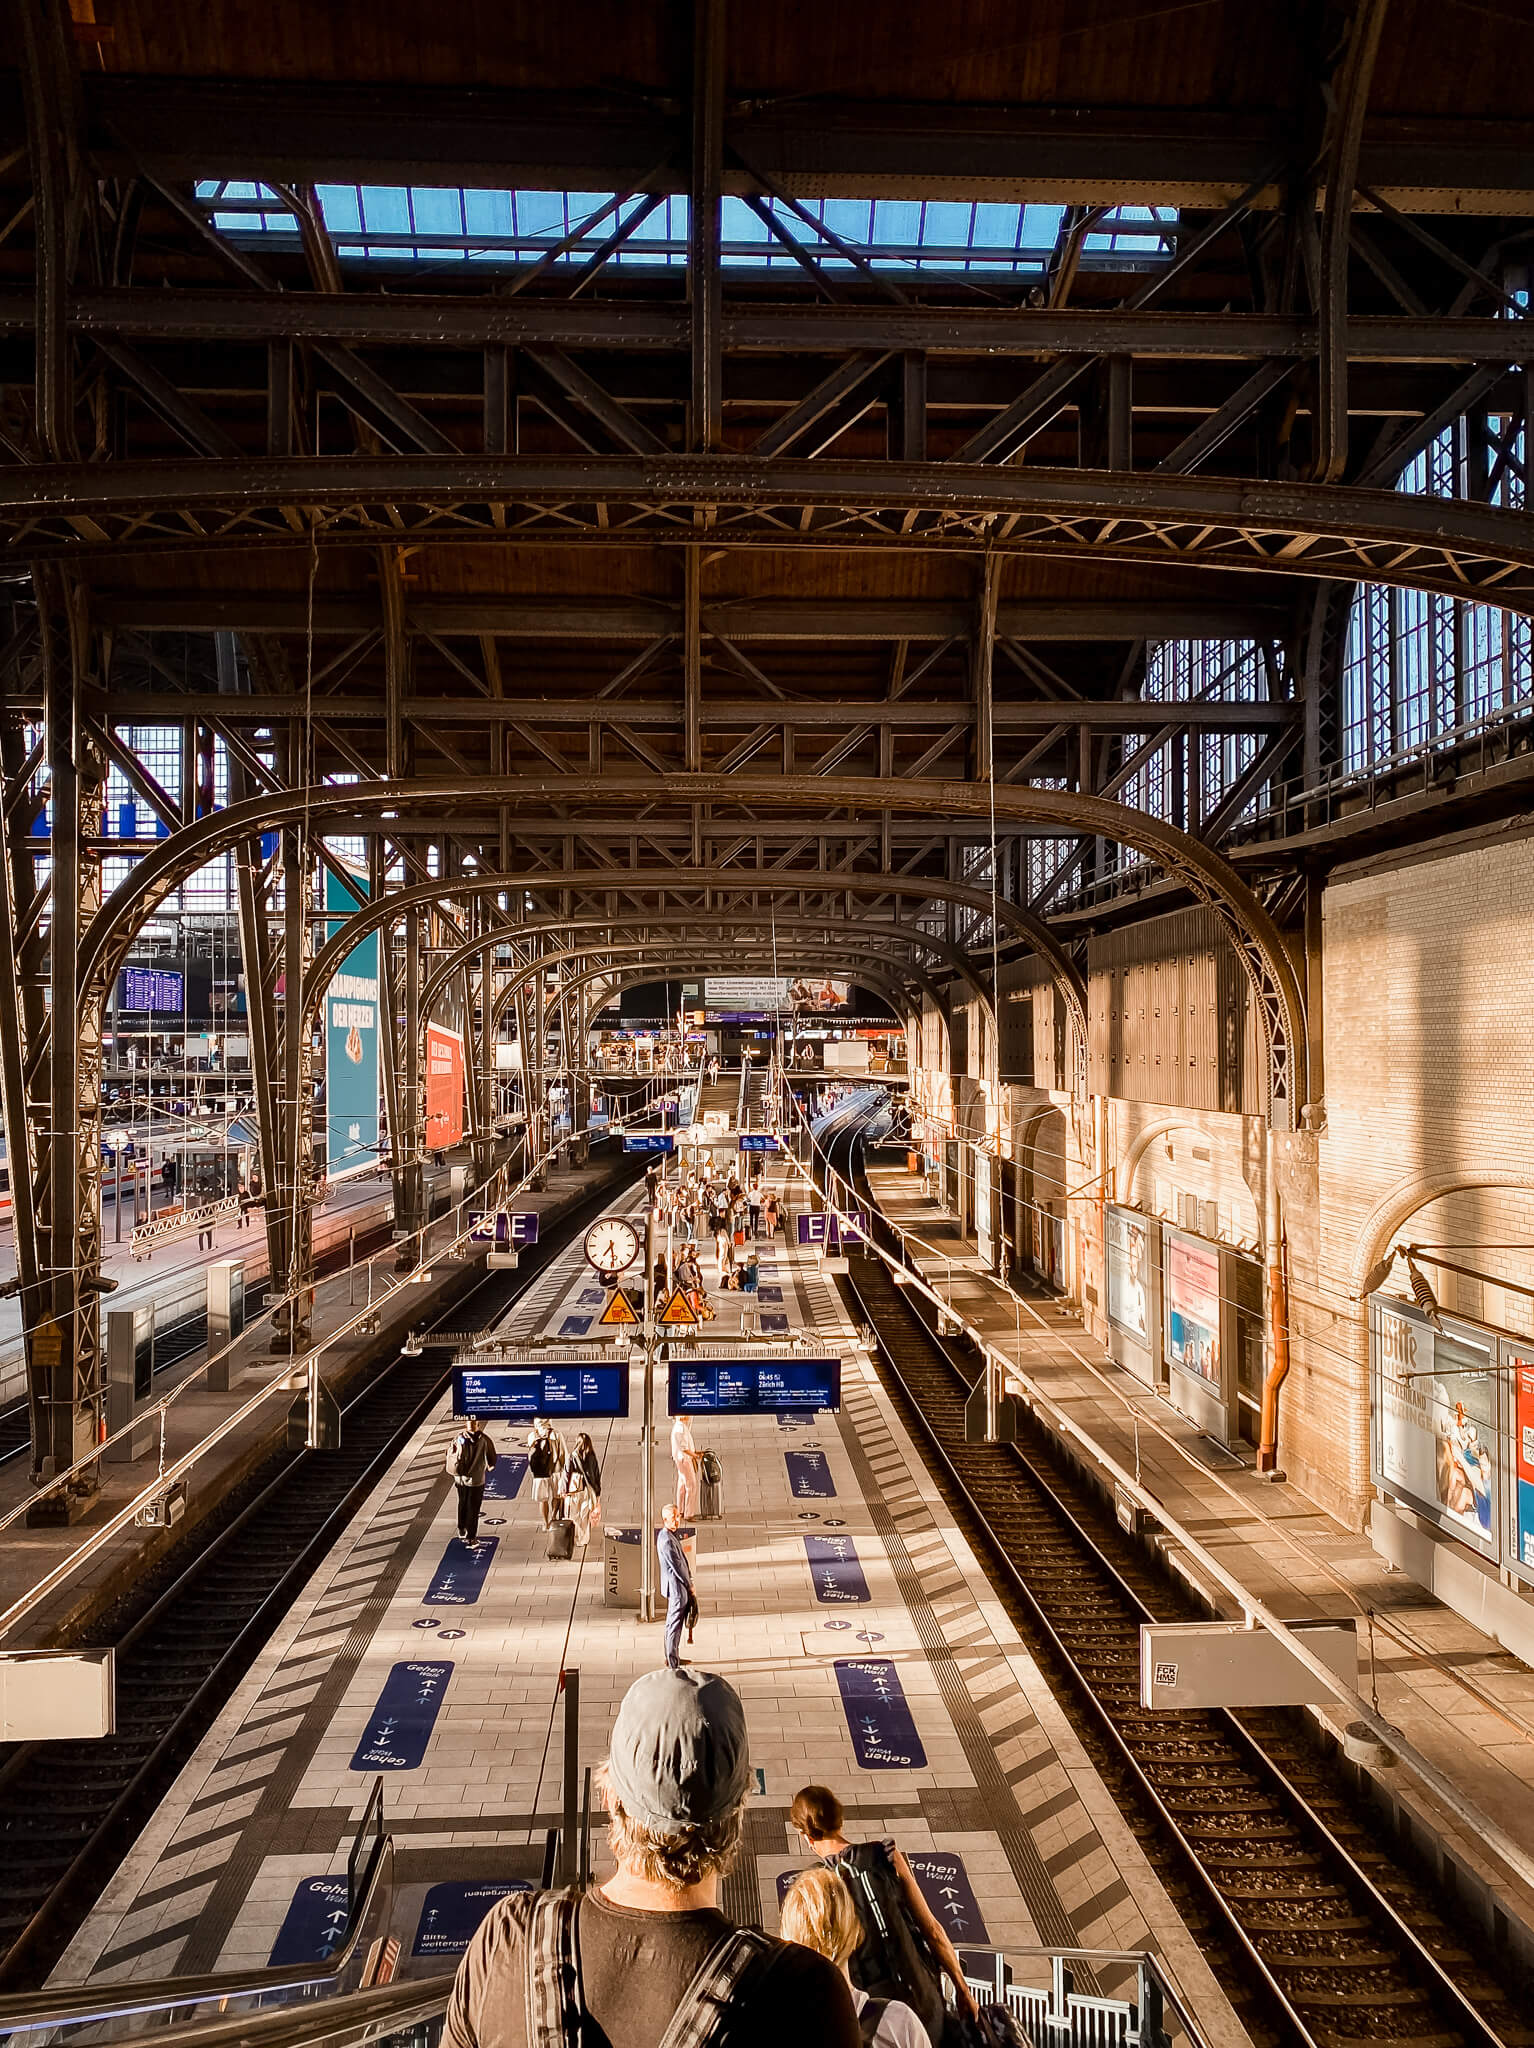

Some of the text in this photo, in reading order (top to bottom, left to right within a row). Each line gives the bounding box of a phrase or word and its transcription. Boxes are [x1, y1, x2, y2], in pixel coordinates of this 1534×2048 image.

[511, 1215, 526, 1238] E
[808, 1216, 824, 1240] E
[608, 1557, 618, 1596] Abfall
[406, 1664, 446, 1675] Gehen
[847, 1662, 888, 1672] Gehen
[1157, 1666, 1176, 1675] FCK
[361, 1753, 407, 1766] Gehen
[864, 1752, 911, 1765] Gehen
[926, 1871, 956, 1882] Walk
[309, 1880, 349, 1896] Gehe
[325, 1894, 349, 1904] Wal
[421, 1939, 469, 1948] weitergeh
